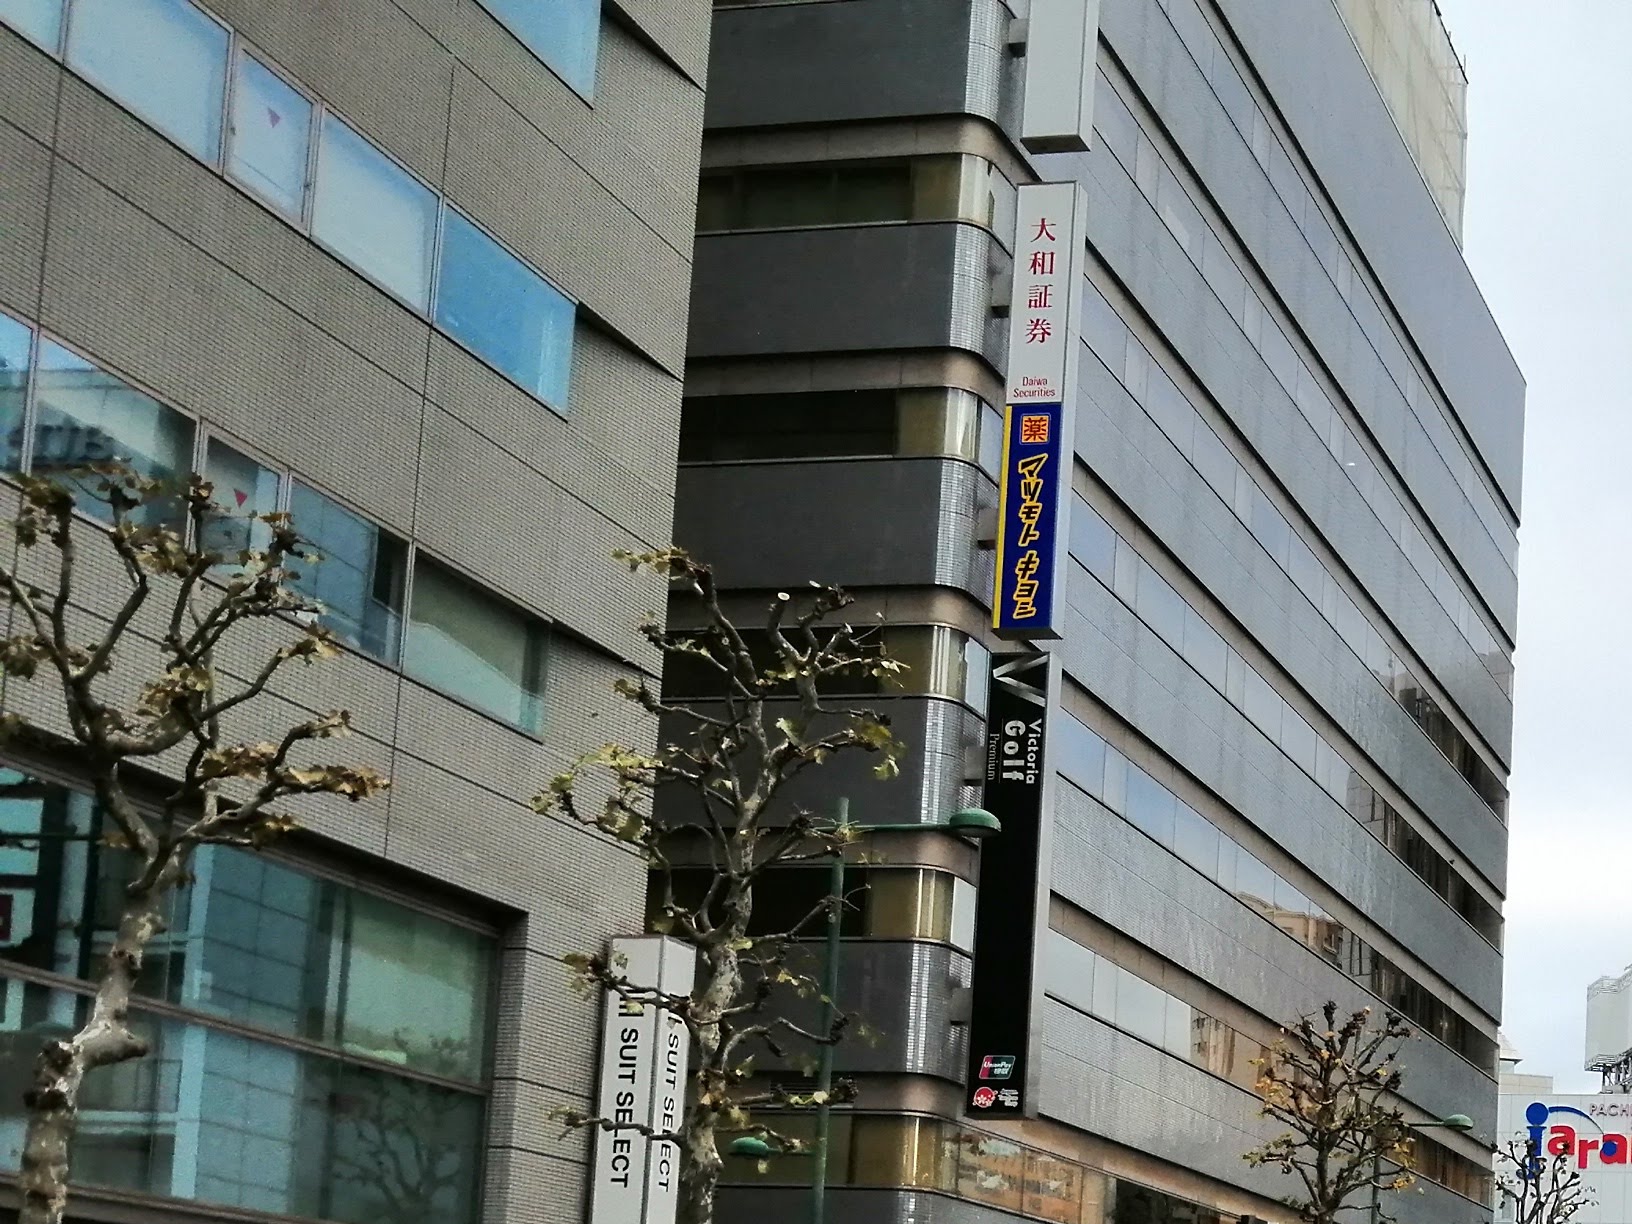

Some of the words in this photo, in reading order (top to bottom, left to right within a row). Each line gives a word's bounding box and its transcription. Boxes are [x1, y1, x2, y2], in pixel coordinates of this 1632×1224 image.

[1025, 217, 1057, 344] 大和証券
[1013, 387, 1056, 398] Securities
[1022, 376, 1048, 386] Daiwa
[1023, 416, 1048, 442] 薬
[987, 733, 1000, 781] Premium
[1002, 720, 1026, 780] Golf
[1025, 718, 1043, 784] Victoria
[617, 1028, 639, 1085] SUIT
[664, 1032, 680, 1090] SUIT
